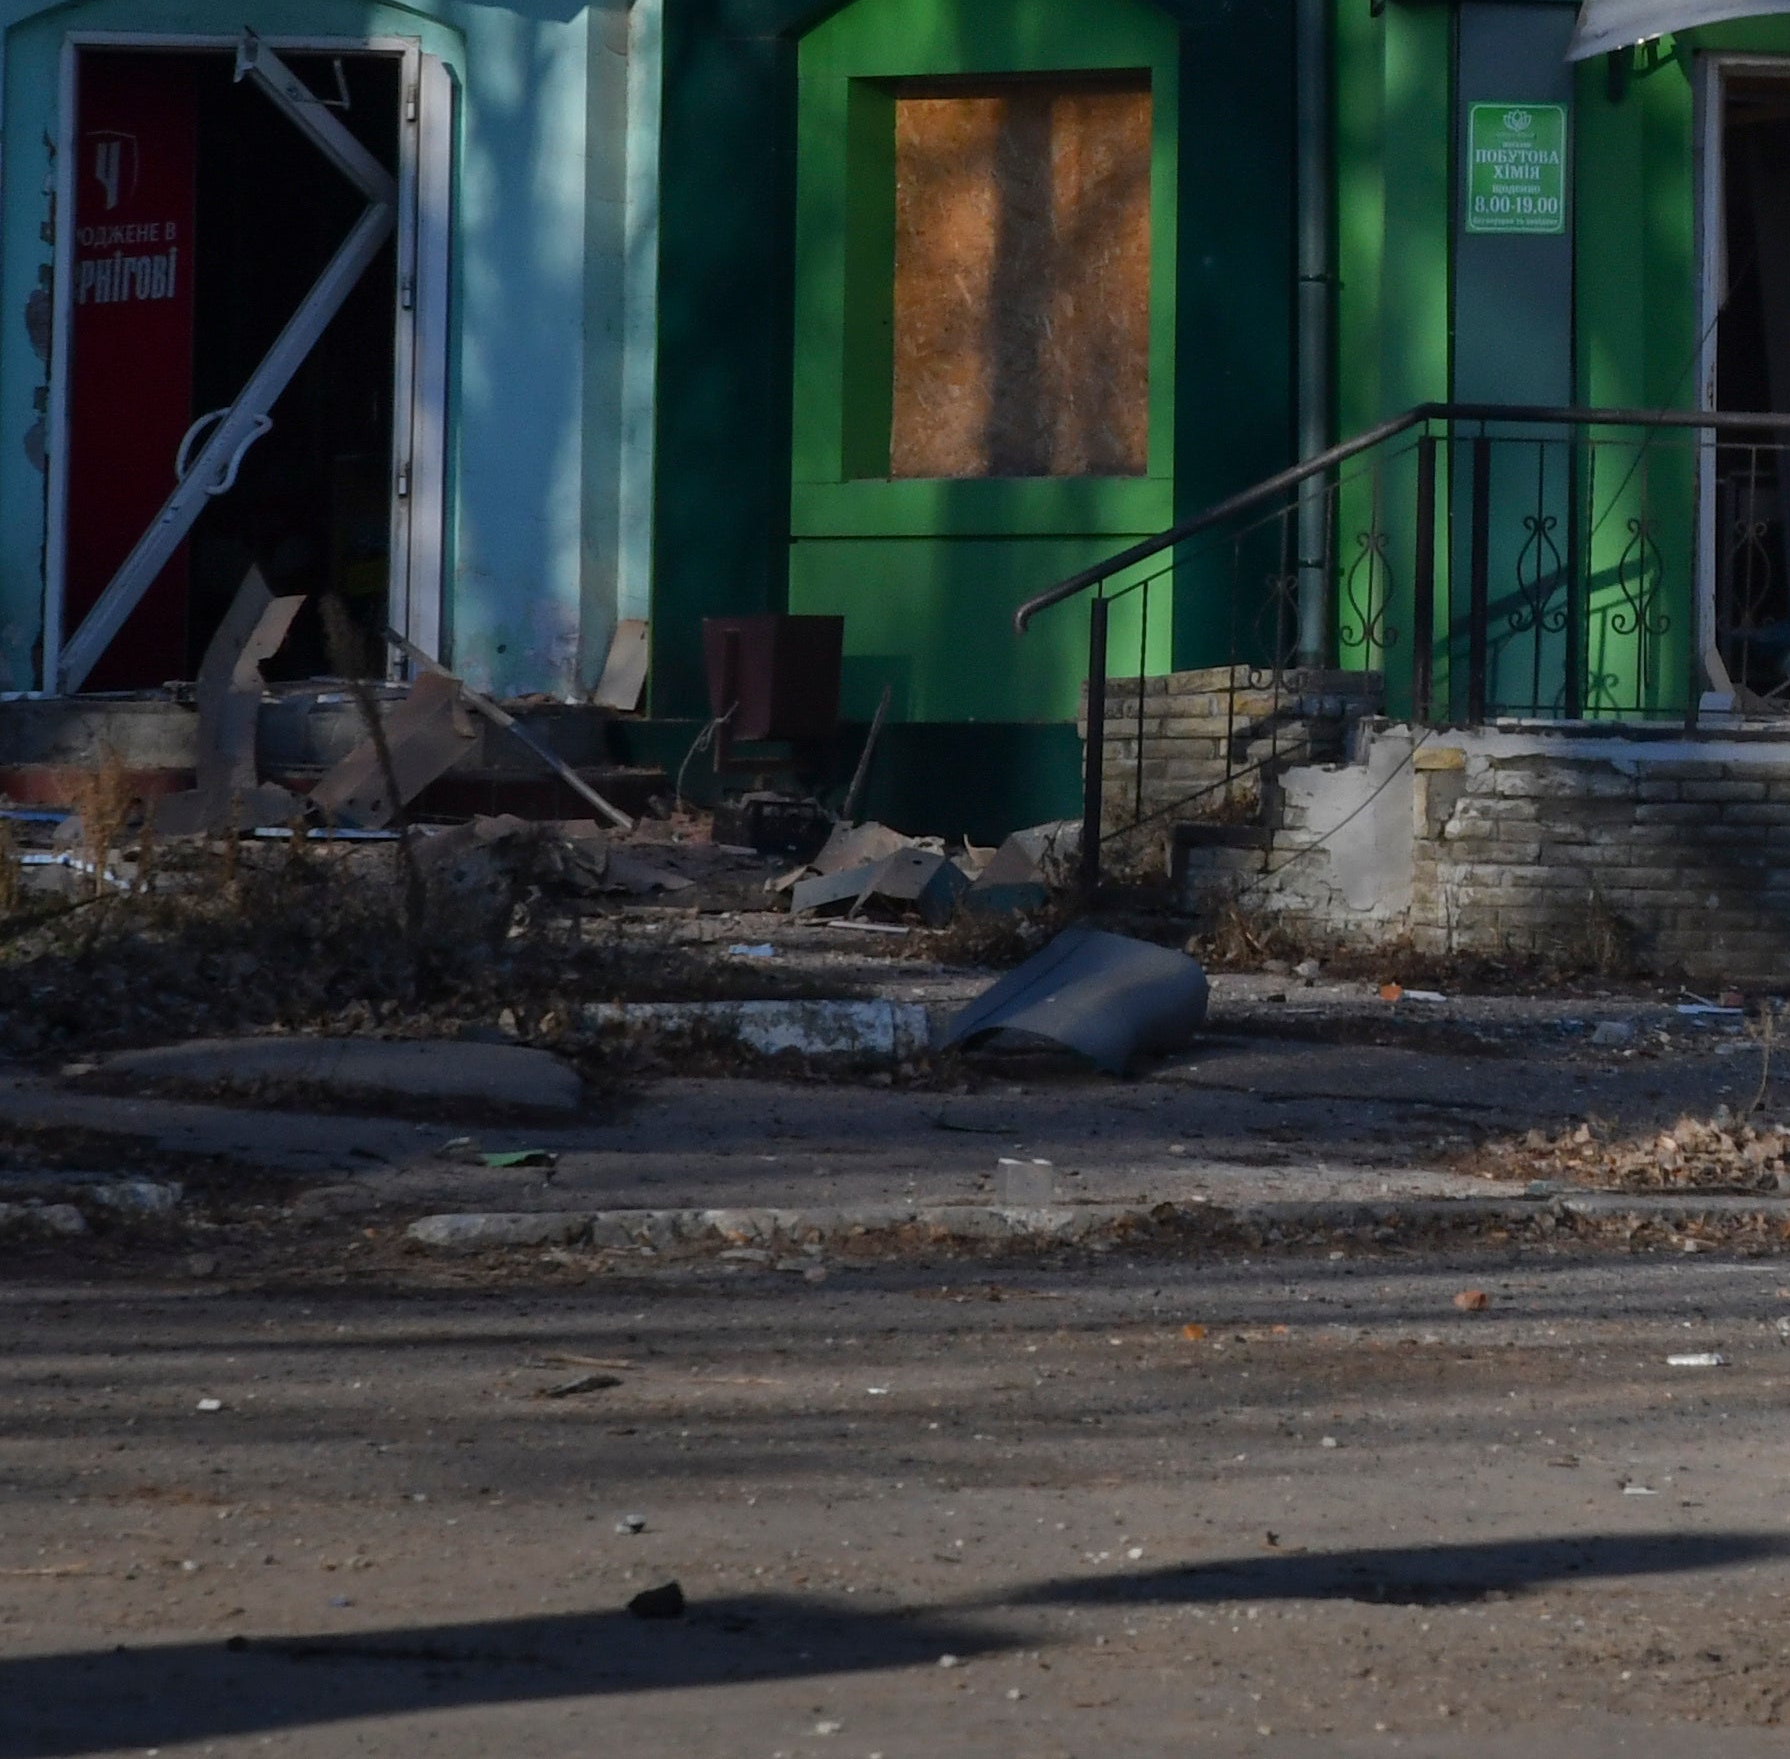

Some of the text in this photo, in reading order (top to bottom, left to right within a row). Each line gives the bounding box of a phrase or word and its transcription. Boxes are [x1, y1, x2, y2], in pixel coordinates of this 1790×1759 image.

[1475, 149, 1559, 164] ПОБУТОВА
[1493, 163, 1540, 179] ХІМІЯ
[1474, 196, 1559, 214] 8.00-19.00
[79, 223, 160, 246] ОДЖЕНЕ
[75, 246, 178, 304] РНІГОВІ
